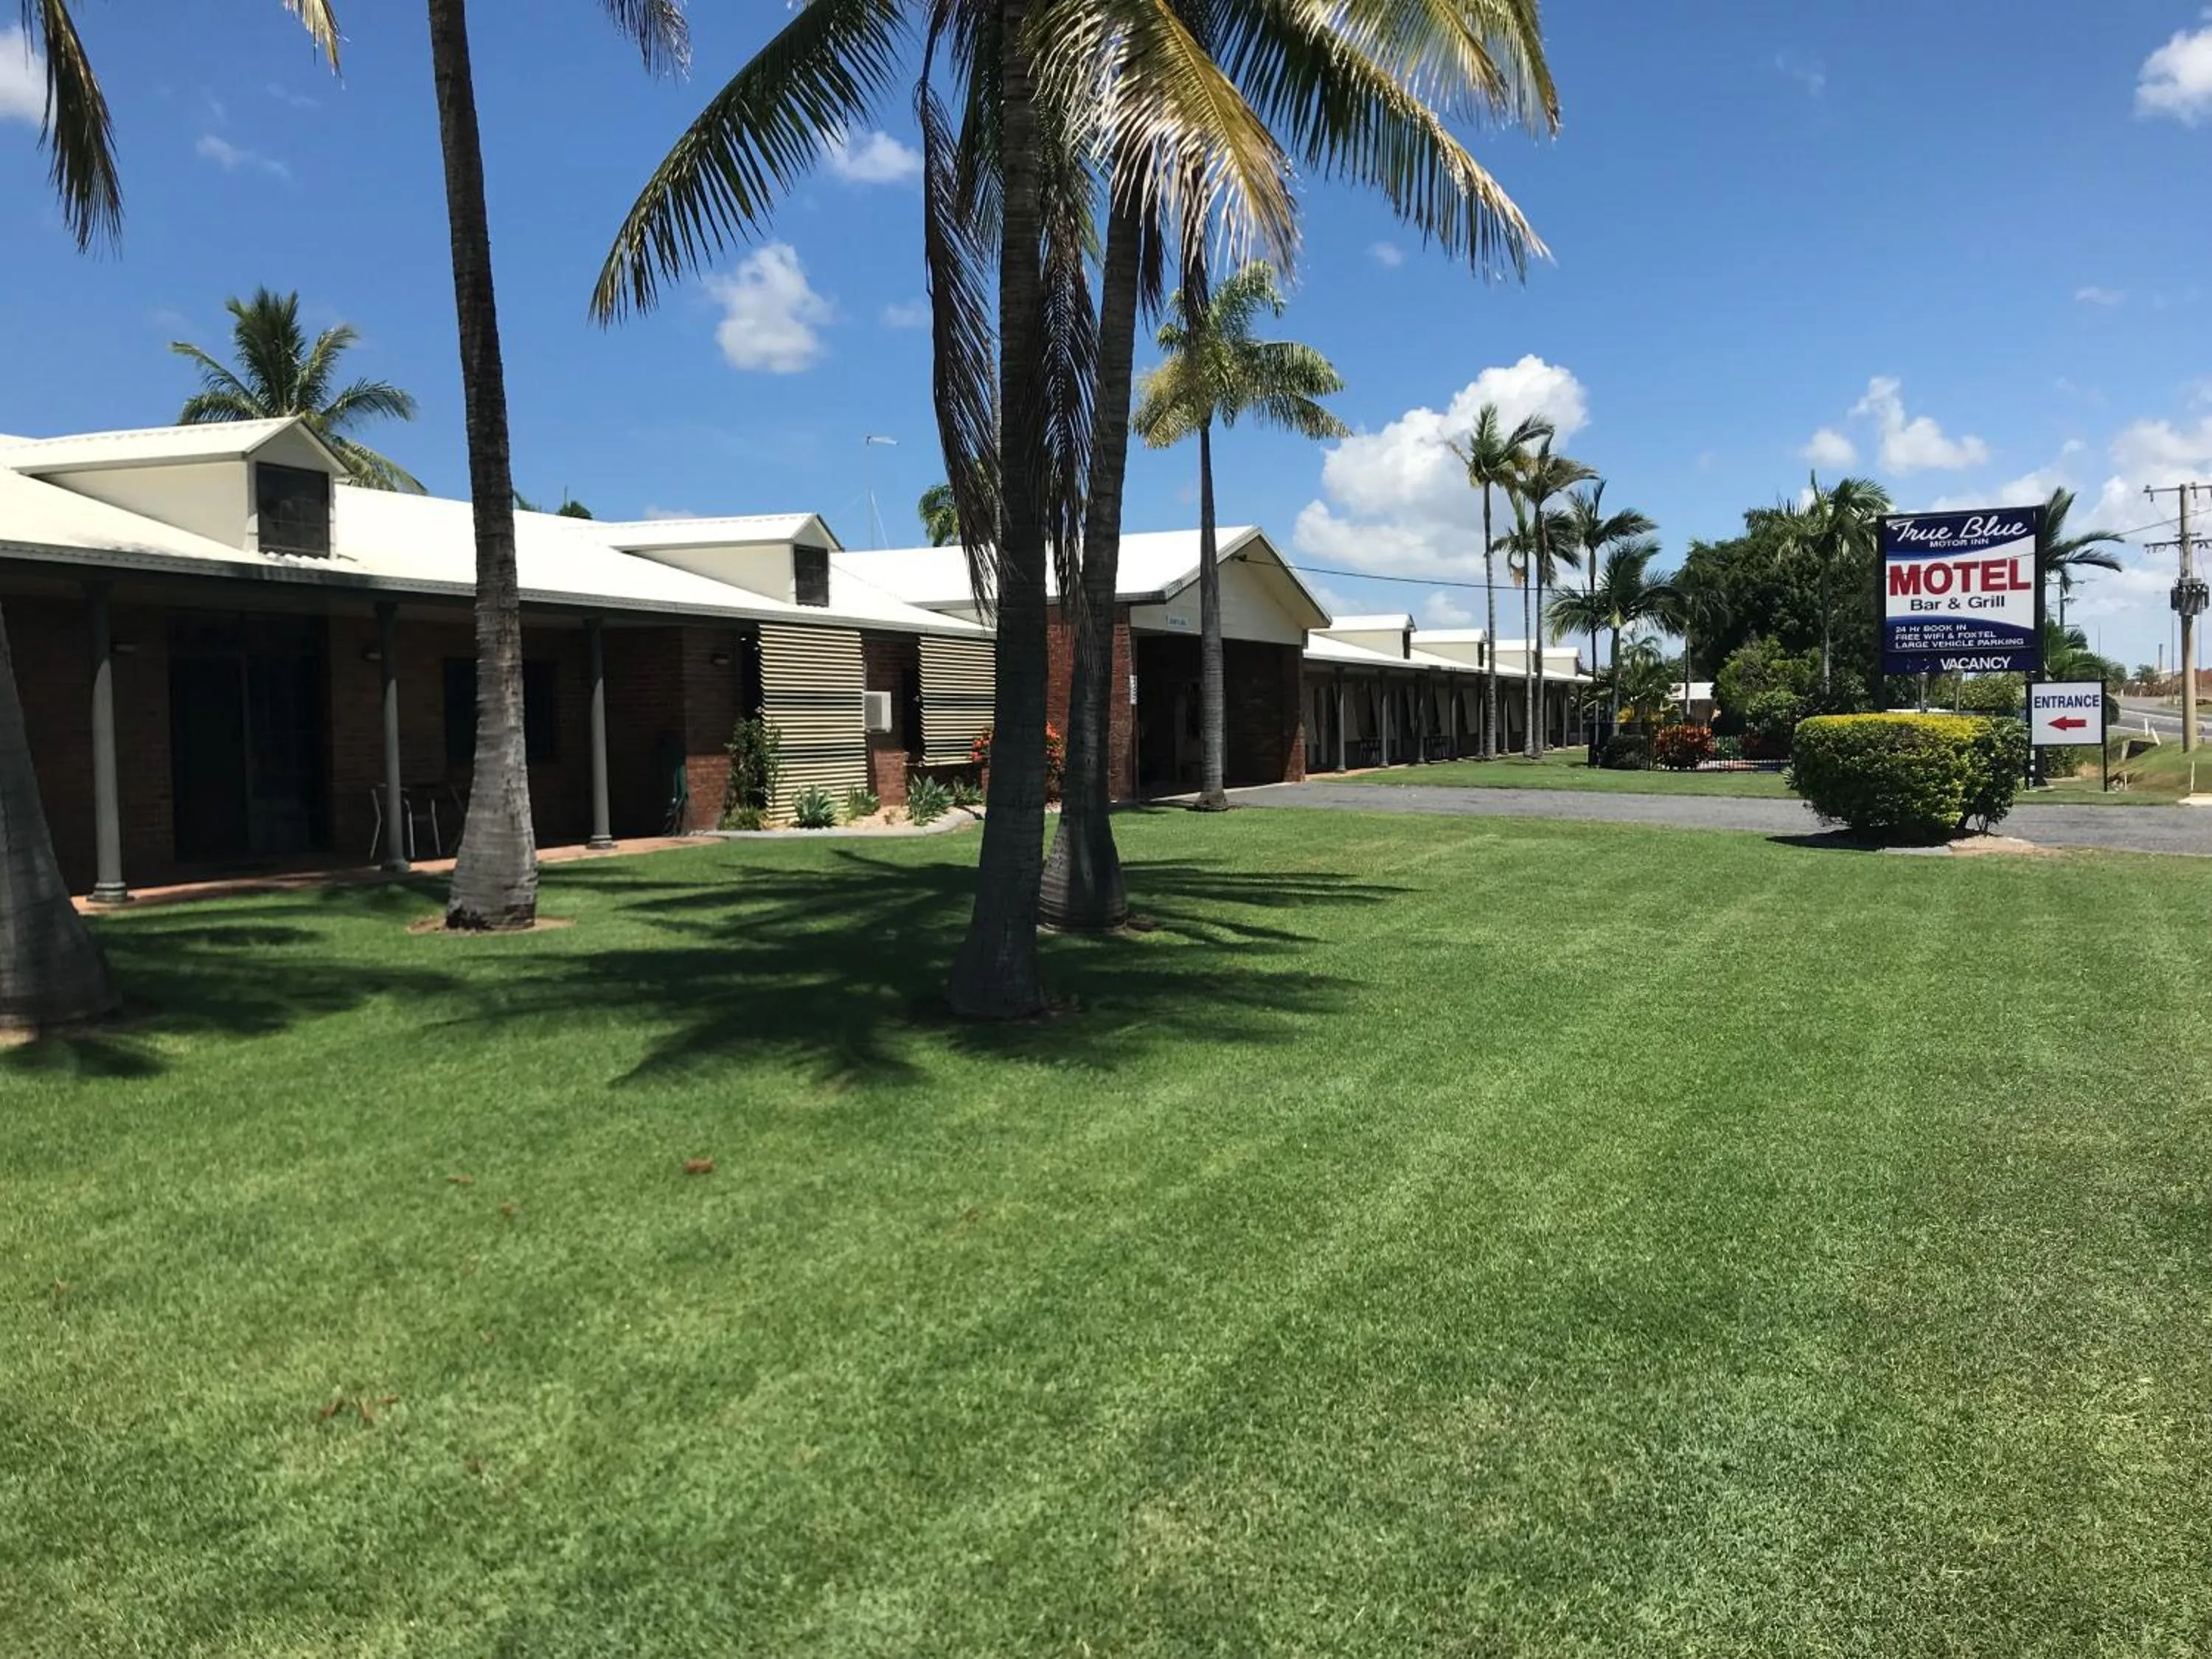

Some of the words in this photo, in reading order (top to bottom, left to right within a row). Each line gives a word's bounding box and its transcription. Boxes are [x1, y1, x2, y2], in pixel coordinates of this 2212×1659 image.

[1891, 519, 1953, 542] True
[1959, 515, 2028, 538] Blue
[1930, 539, 1968, 548] MOTOR
[1890, 558, 2031, 596] MOTEL
[1910, 599, 1941, 611] Bar
[1947, 597, 1961, 610] &
[1968, 595, 2005, 608] Grill
[1896, 641, 1929, 649] LARGE
[1931, 639, 1974, 647] VEHICLE
[1977, 638, 2024, 646] PARKING
[1940, 656, 2011, 670] VACANCY
[2034, 695, 2100, 709] ENTRANCE
